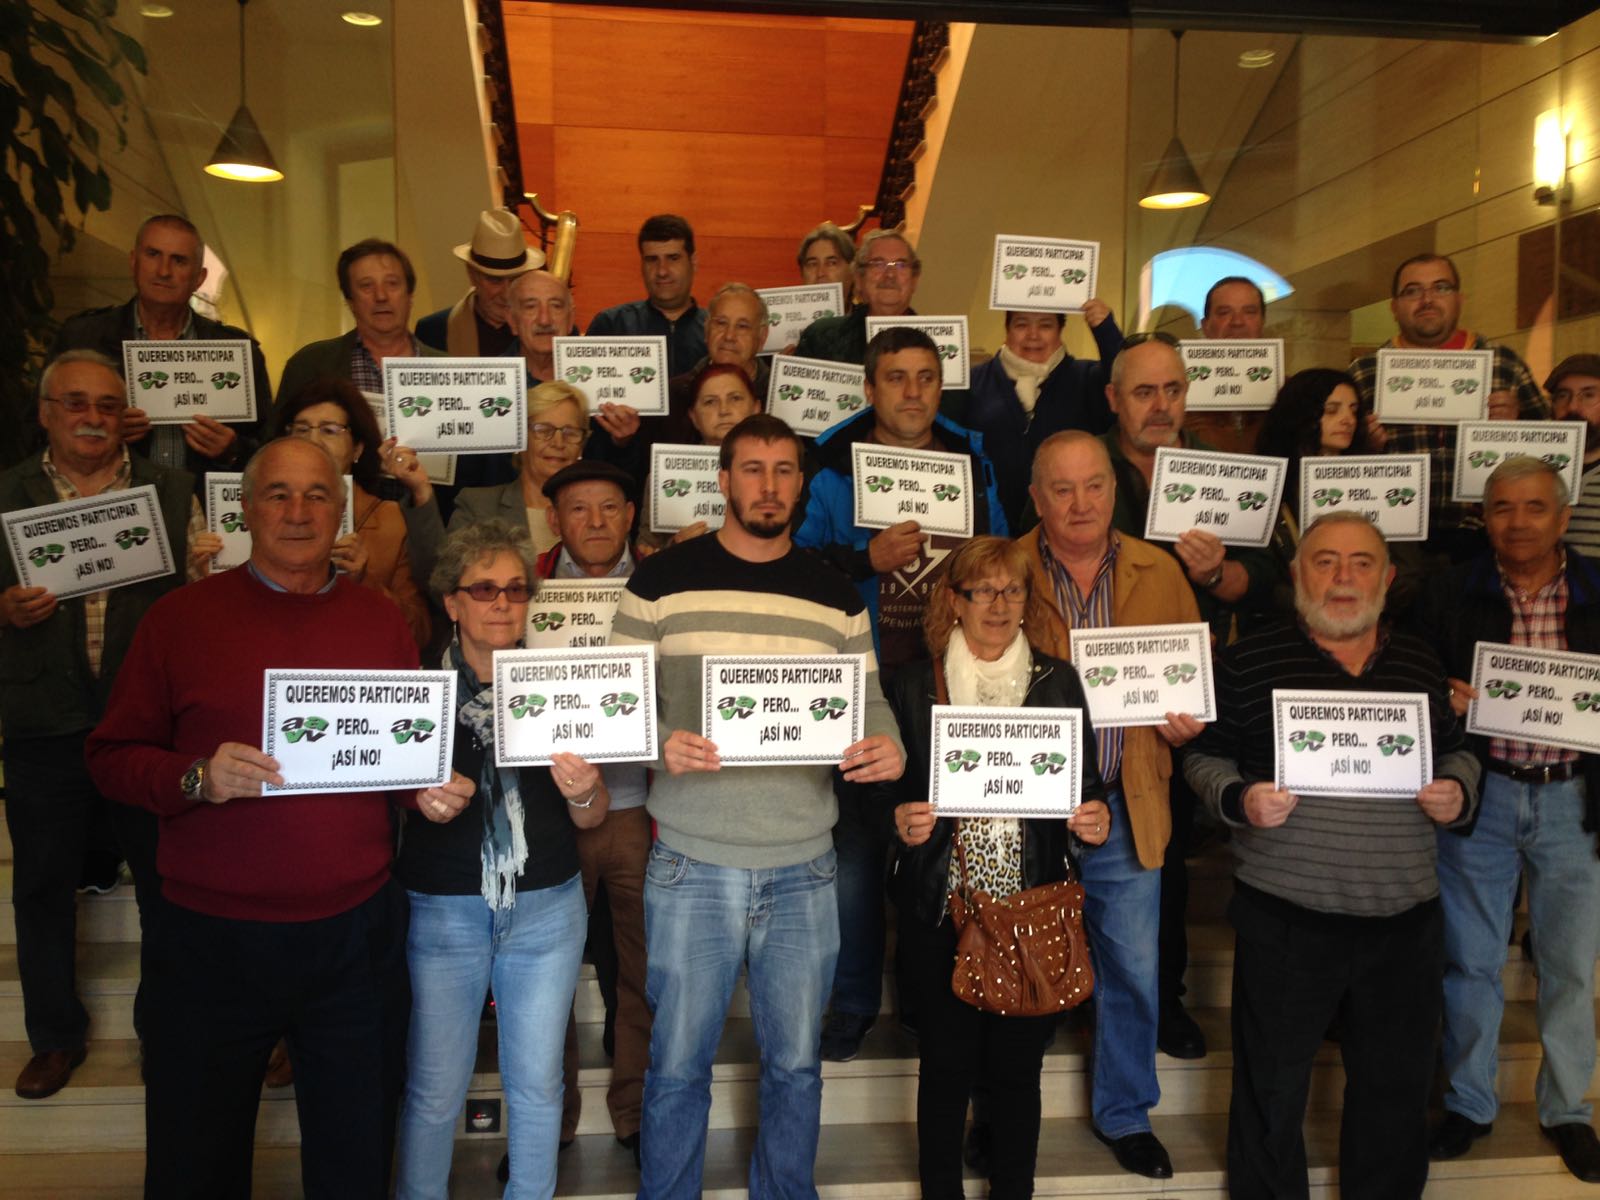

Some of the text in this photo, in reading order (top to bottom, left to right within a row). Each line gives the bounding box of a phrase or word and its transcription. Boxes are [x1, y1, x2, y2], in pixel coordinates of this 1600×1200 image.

[1006, 246, 1085, 260] QUEREMOS PARTICIPAR
[766, 295, 793, 306] UEREMOS
[138, 350, 234, 363] QUEREMOS PARTICIPAR
[566, 346, 651, 358] QUEREMOS PARTICIPAR
[1188, 348, 1268, 359] QUEREMOS PARTICIPAR
[1390, 358, 1476, 370] QUEREMOS PARTICIPAR
[399, 372, 506, 386] QUEREMOS PARTICIPAR
[782, 365, 862, 386] QUEREMOS PARTICIPAR
[192, 393, 208, 405] NO!
[458, 422, 474, 435] NO!
[1472, 431, 1568, 443] QUEREMOS PARTICIPAR
[665, 458, 709, 470] QUEREMOS
[866, 456, 955, 475] QUEREMOS PARTICIPAR
[1169, 460, 1268, 480] QUEREMOS PARTICIPAR
[1315, 465, 1411, 480] QUEREMOS PARTICIPAR
[915, 502, 928, 514] NO!
[23, 504, 139, 538] QUEREMOS PARTICIPAR
[1214, 512, 1229, 525] NO!
[96, 557, 115, 572] NO!
[535, 590, 584, 603] QUEREMOS
[1085, 638, 1189, 657] QUEREMOS PARTICIPAR
[510, 663, 631, 683] QUEREMOS PARTICIPAR
[1491, 655, 1600, 682] QUEREMOS PARTICIPA
[720, 668, 842, 684] QUEREMOS PARTICIPAR
[286, 685, 429, 703] QUEREMOS PARTICIPAR
[1143, 690, 1159, 703] NO!
[554, 694, 589, 709] PERO...
[763, 697, 799, 712] PERO...
[1290, 706, 1407, 722] QUEREMOS PARTICIPAR
[1545, 712, 1562, 725] NO!
[337, 718, 379, 735] PERO...
[576, 723, 593, 738] NO!
[784, 726, 801, 741] NO!
[948, 723, 1060, 739] QUEREMOS PARTICIPAR
[360, 749, 381, 765] NO!
[987, 752, 1021, 766] PERO...
[1353, 760, 1371, 774] NO!
[1006, 780, 1023, 794] NO!
